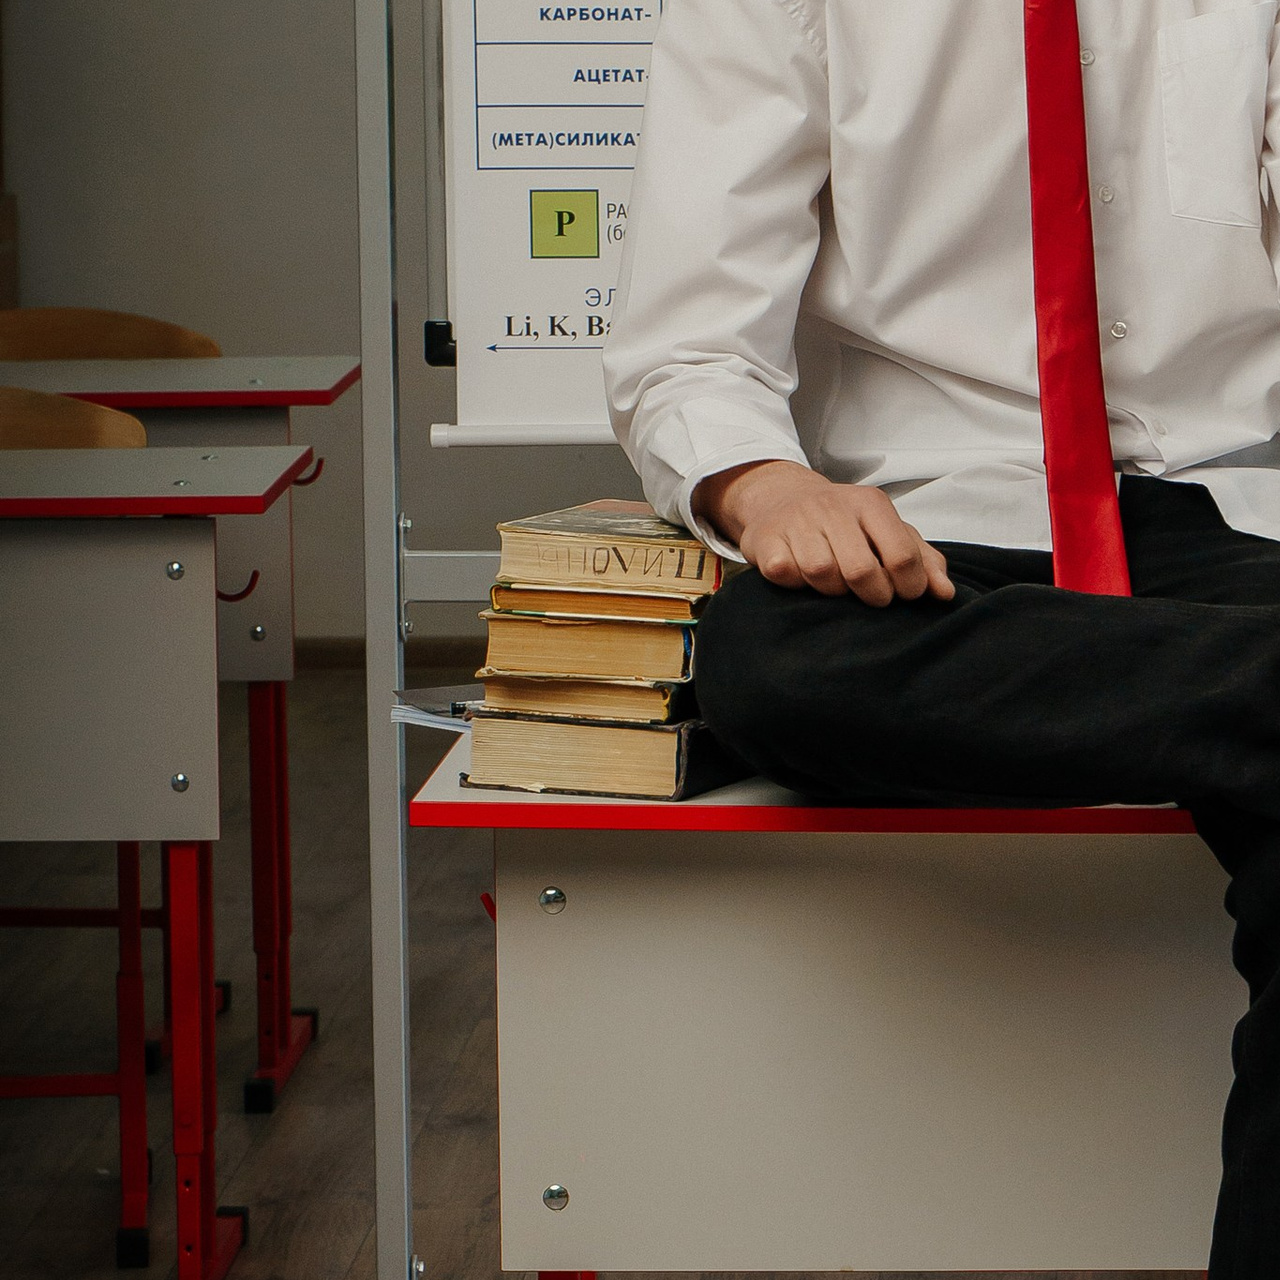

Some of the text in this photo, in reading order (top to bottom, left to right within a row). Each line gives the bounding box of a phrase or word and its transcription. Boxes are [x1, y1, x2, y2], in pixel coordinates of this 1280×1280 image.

[539, 7, 652, 21] КАРБОНАТ-
[555, 210, 576, 237] Р
[506, 315, 539, 340] Li,
[549, 315, 577, 341] K,
